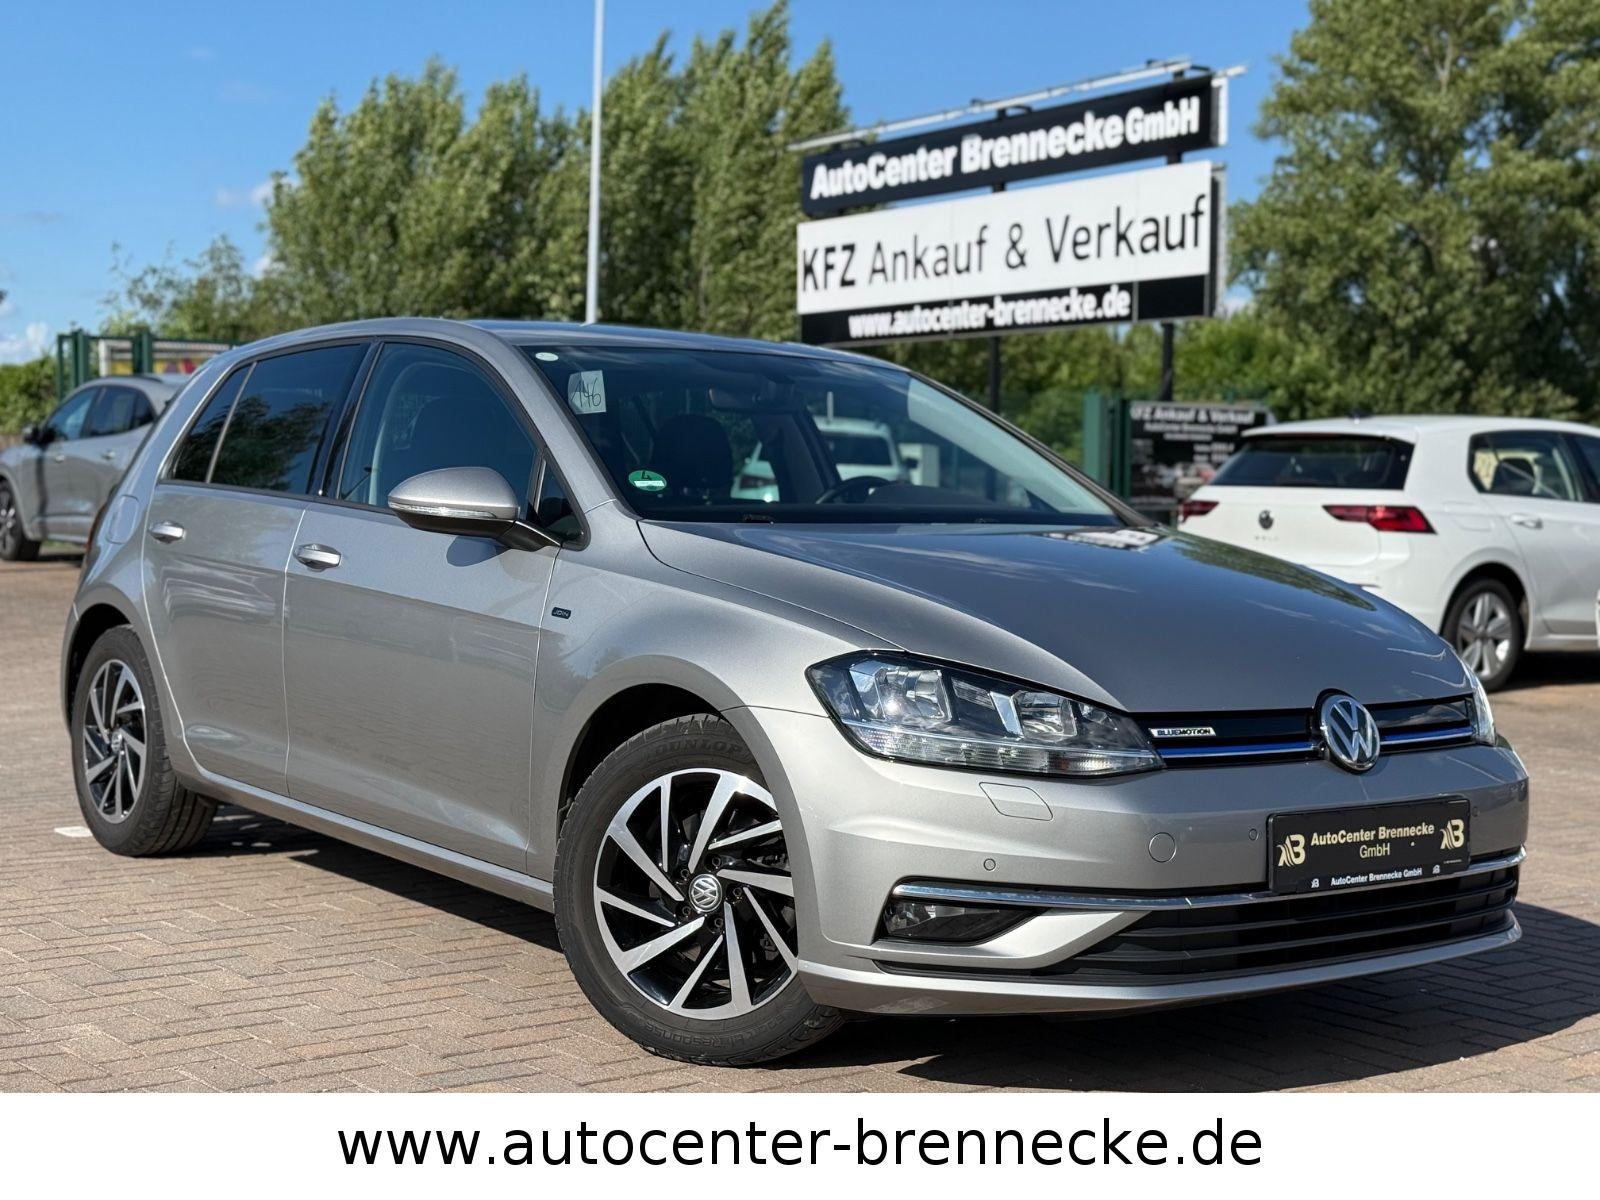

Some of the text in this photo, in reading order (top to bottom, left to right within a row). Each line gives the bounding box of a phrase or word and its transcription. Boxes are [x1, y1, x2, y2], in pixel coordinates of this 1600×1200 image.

[810, 96, 1199, 199] AutoCenter Brennecke GmbH
[803, 194, 1206, 292] KFZ Ankauf & Verkauf
[848, 285, 1131, 339] www.autocenter-brennecke.de
[1157, 728, 1211, 736] BLUEMOTION
[1310, 822, 1435, 847] AutoCenter Brennecke
[1359, 843, 1391, 859] GmbH
[1330, 873, 1368, 886] AutoCenter
[1369, 870, 1402, 881] Brennecke
[1403, 867, 1422, 877] GmbH
